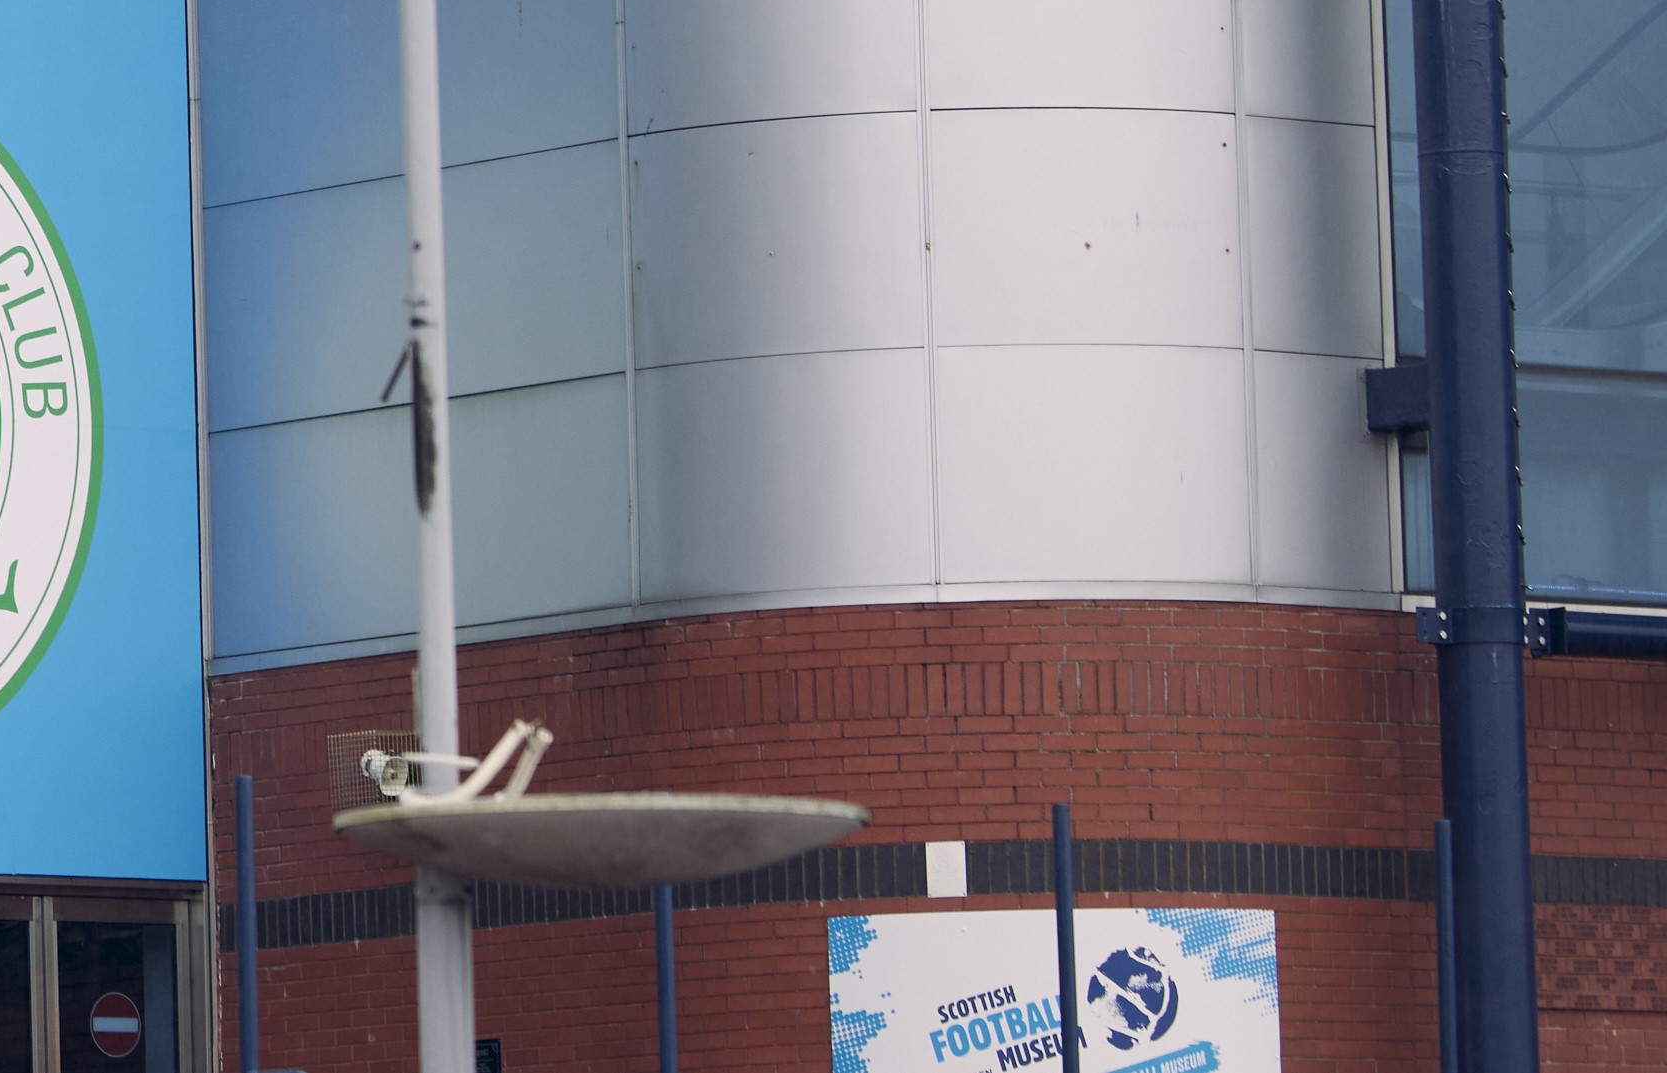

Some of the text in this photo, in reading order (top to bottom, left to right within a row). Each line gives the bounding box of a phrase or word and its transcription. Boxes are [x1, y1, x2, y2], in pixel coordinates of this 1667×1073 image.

[938, 985, 1017, 1023] SCOTTISH
[929, 994, 1062, 1063] FOOTBAL
[1160, 1049, 1207, 1073] MUSEUM
